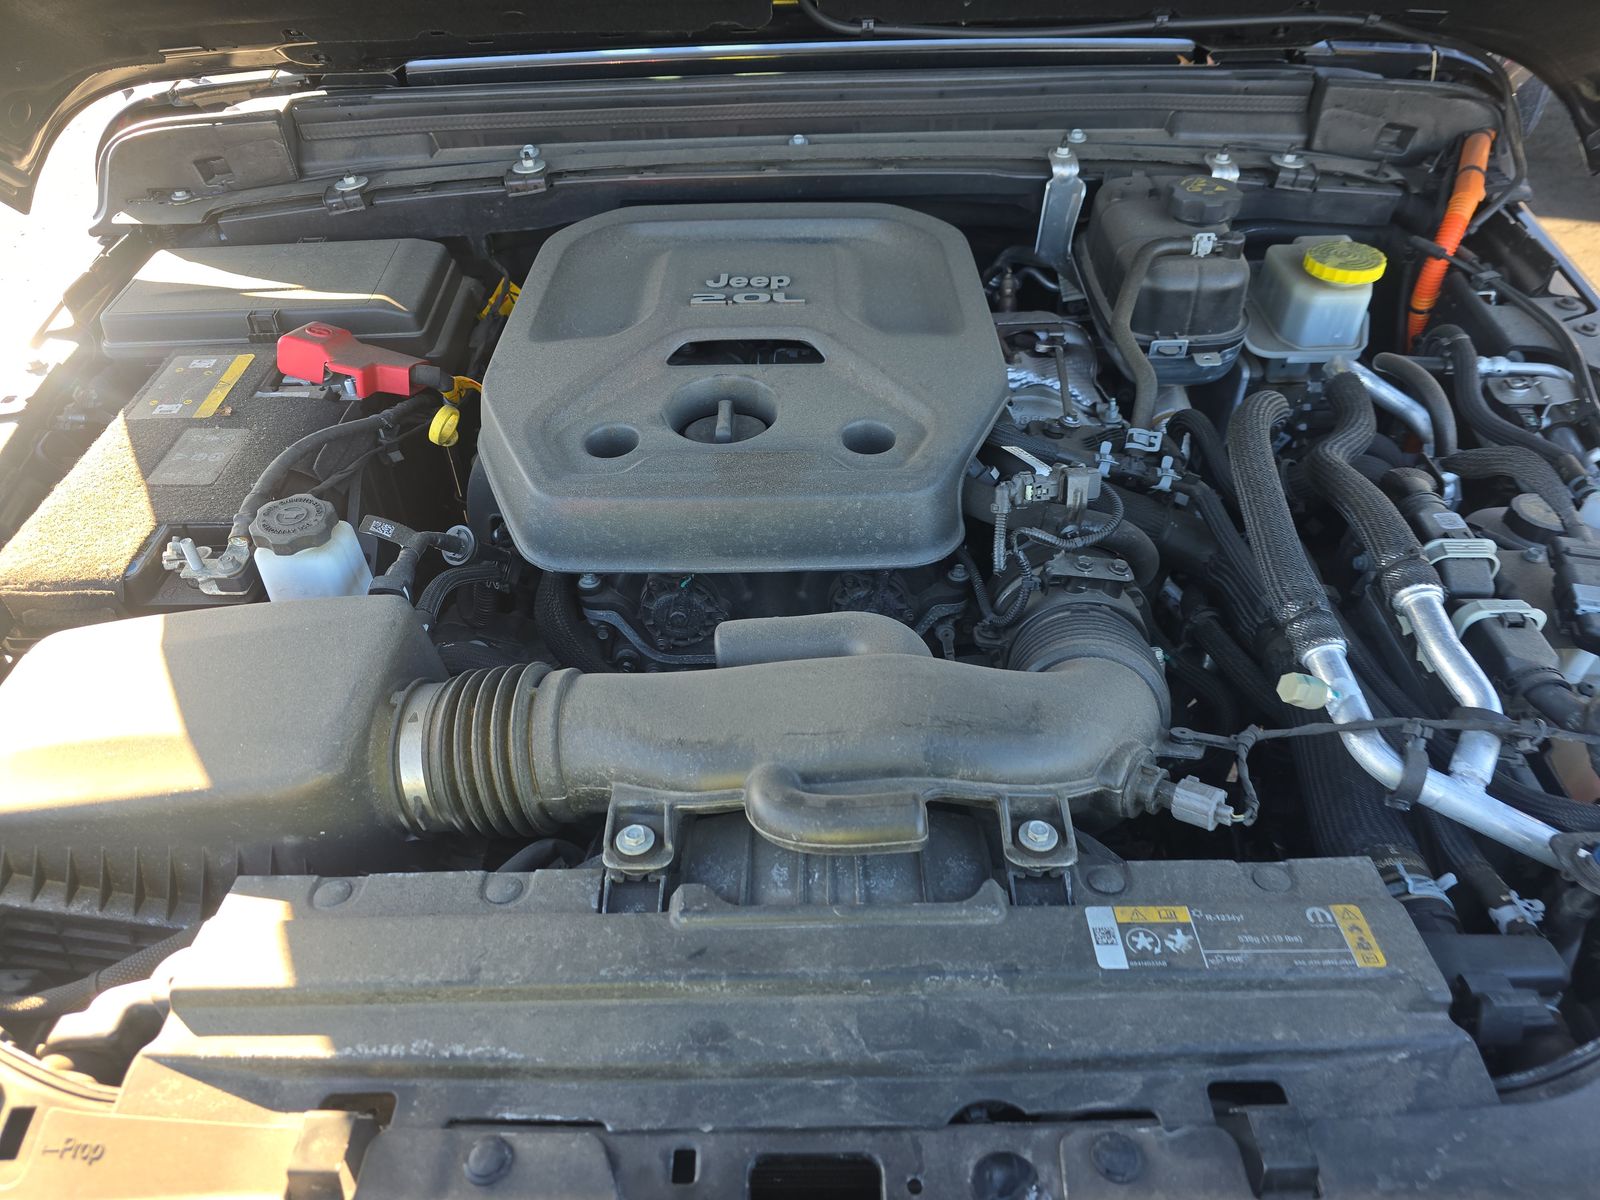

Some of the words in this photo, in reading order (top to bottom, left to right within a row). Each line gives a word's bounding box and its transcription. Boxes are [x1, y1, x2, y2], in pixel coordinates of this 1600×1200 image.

[705, 273, 791, 290] Jeep
[690, 292, 806, 305] 2.0L
[60, 1138, 105, 1166] Prop
